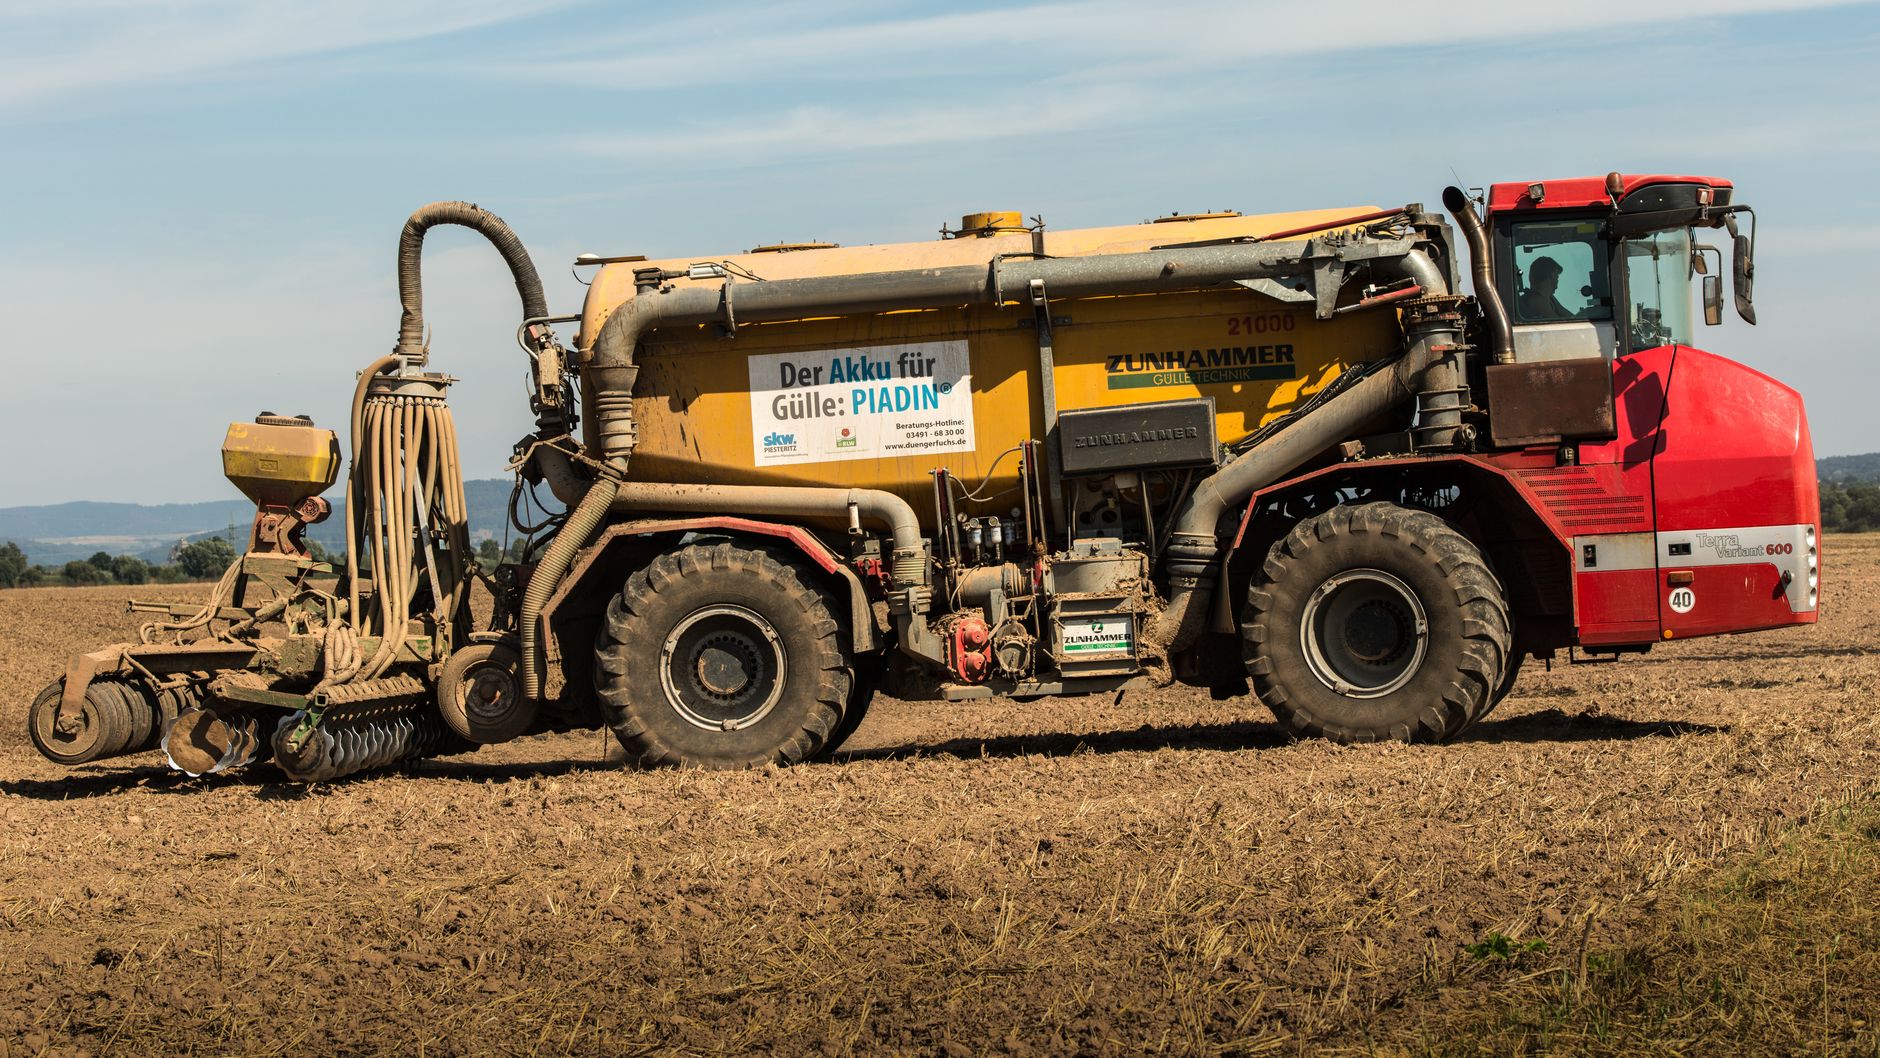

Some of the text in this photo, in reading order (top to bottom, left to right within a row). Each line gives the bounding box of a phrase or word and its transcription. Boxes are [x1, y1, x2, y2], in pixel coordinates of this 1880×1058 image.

[1228, 314, 1296, 336] 21000
[1106, 344, 1296, 374] ZUNHAMMER
[780, 352, 936, 388] Der Akku für
[772, 391, 845, 421] Gülle:
[896, 419, 965, 430] Beratungs-Hotline:
[906, 431, 928, 439] 03491
[1075, 426, 1197, 448] ZUNHAMMER
[764, 445, 797, 453] PIESTERITZ
[884, 438, 967, 450] www.duengerfuchs.de
[1696, 533, 1740, 548] Terra
[1715, 543, 1793, 558] Variant 600
[1672, 591, 1691, 608] 40
[1064, 633, 1131, 644] ZUNHAMMER
